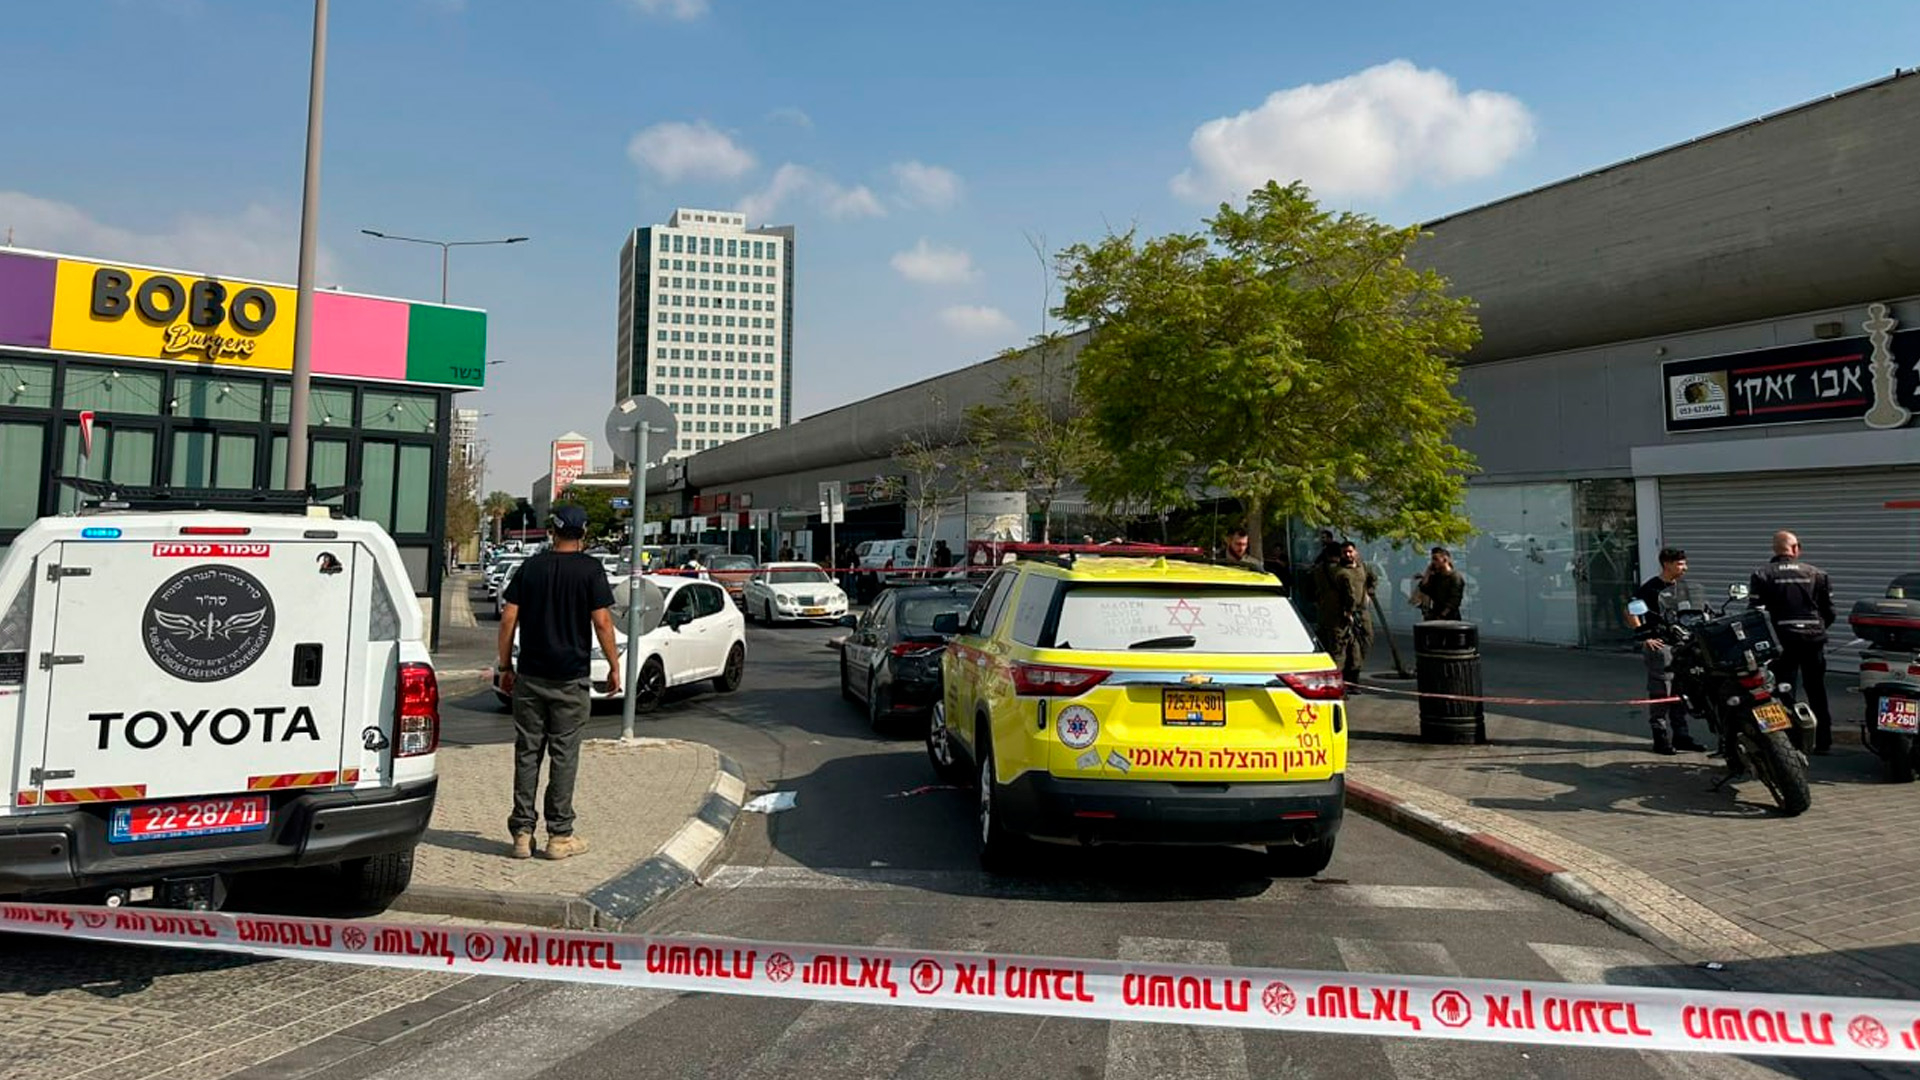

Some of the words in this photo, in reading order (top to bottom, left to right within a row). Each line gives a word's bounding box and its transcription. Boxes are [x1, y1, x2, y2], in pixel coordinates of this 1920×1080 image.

[92, 268, 276, 334] BOBO
[165, 324, 256, 358] Burgers
[449, 366, 482, 380] כשר
[1810, 366, 1863, 398] אבו
[1735, 373, 1797, 416] זאקי
[155, 544, 212, 556] מרחק
[218, 544, 267, 555] שמור
[149, 626, 165, 656] PUBLIC
[160, 653, 188, 675] ORDER
[187, 666, 230, 678] DEFENCE
[88, 706, 320, 750] TOYOTA
[1880, 712, 1916, 726] 73-260
[1296, 732, 1320, 748] 101
[1128, 747, 1203, 768] הלאומי
[1209, 747, 1278, 769] ההצלה
[1283, 749, 1327, 773] ארגון
